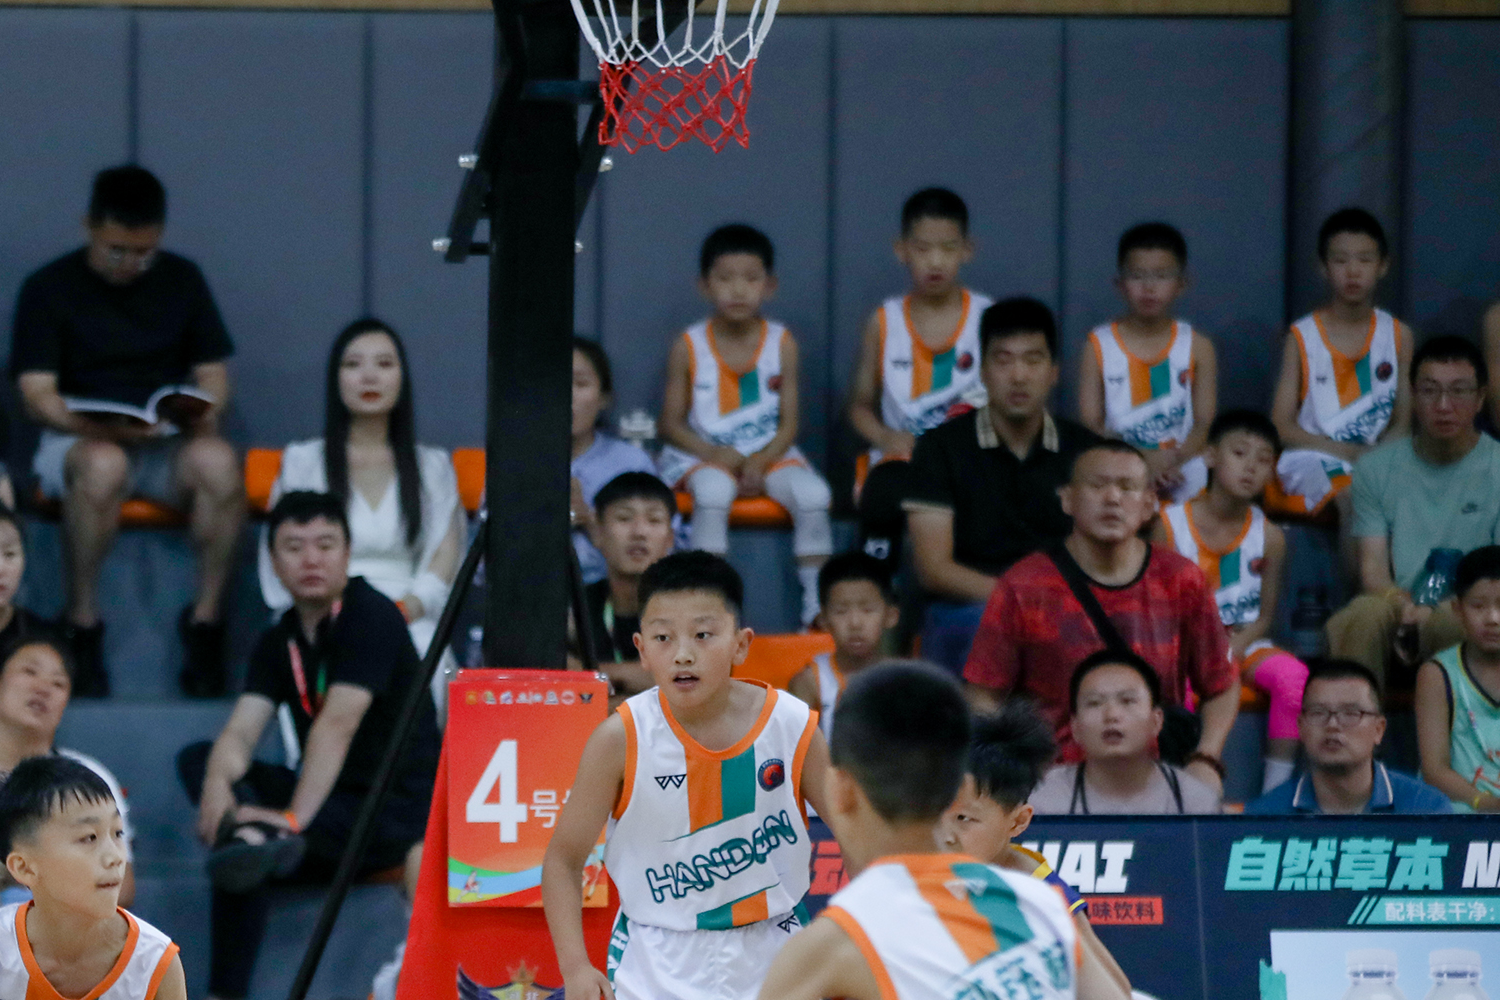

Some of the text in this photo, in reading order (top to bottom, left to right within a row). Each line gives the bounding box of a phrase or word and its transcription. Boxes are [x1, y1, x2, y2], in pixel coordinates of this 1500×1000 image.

[466, 739, 571, 843] 4号
[646, 809, 798, 903] HANDAN
[1224, 837, 1500, 891] 自然草本 N
[1086, 901, 1155, 921] 味饮料
